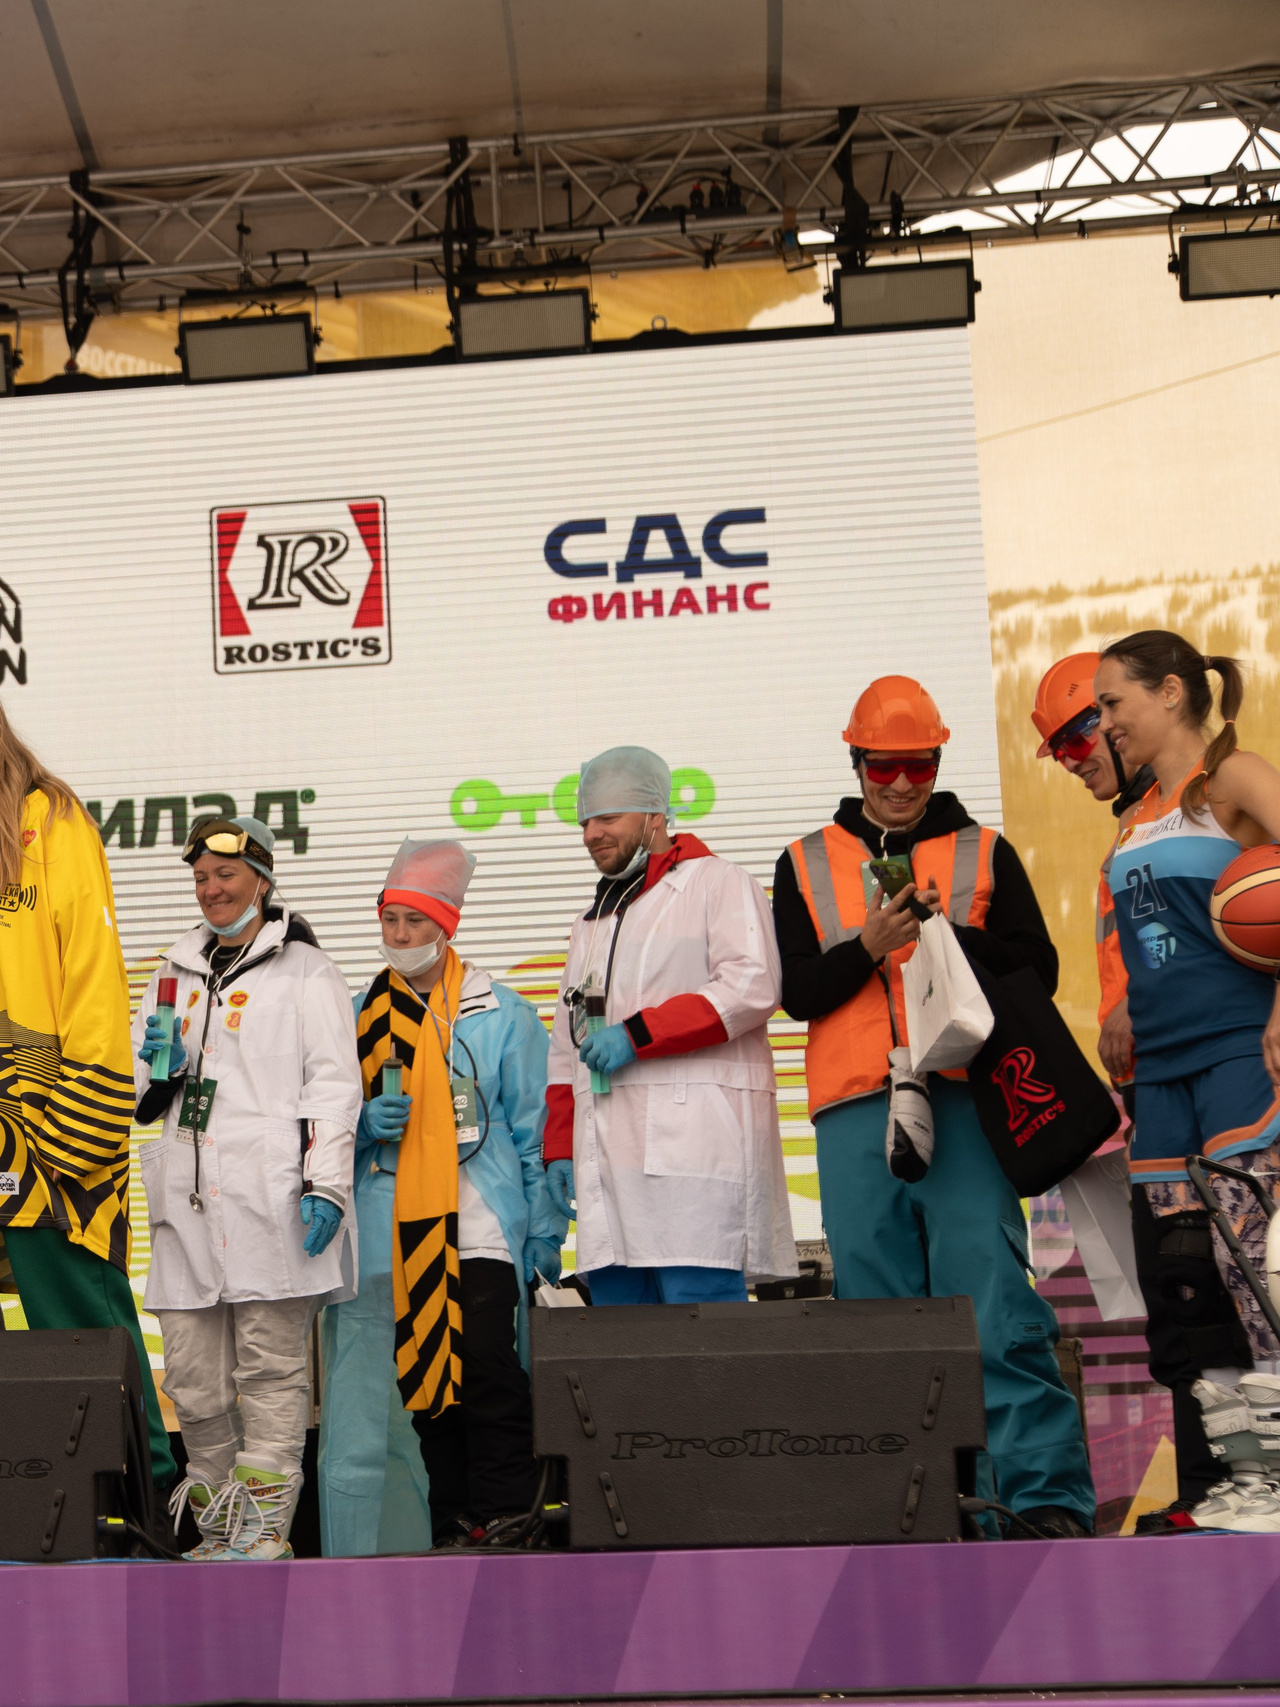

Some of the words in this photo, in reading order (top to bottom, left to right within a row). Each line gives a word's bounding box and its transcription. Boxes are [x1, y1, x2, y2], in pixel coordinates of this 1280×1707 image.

[543, 506, 769, 583] СДС
[247, 529, 351, 612] R
[547, 582, 771, 624] ФИНАНС
[223, 635, 382, 666] ROSTIC'S
[1125, 861, 1168, 919] 21
[1014, 1099, 1066, 1148] ROSTIC'S
[611, 1429, 910, 1460] ProTone
